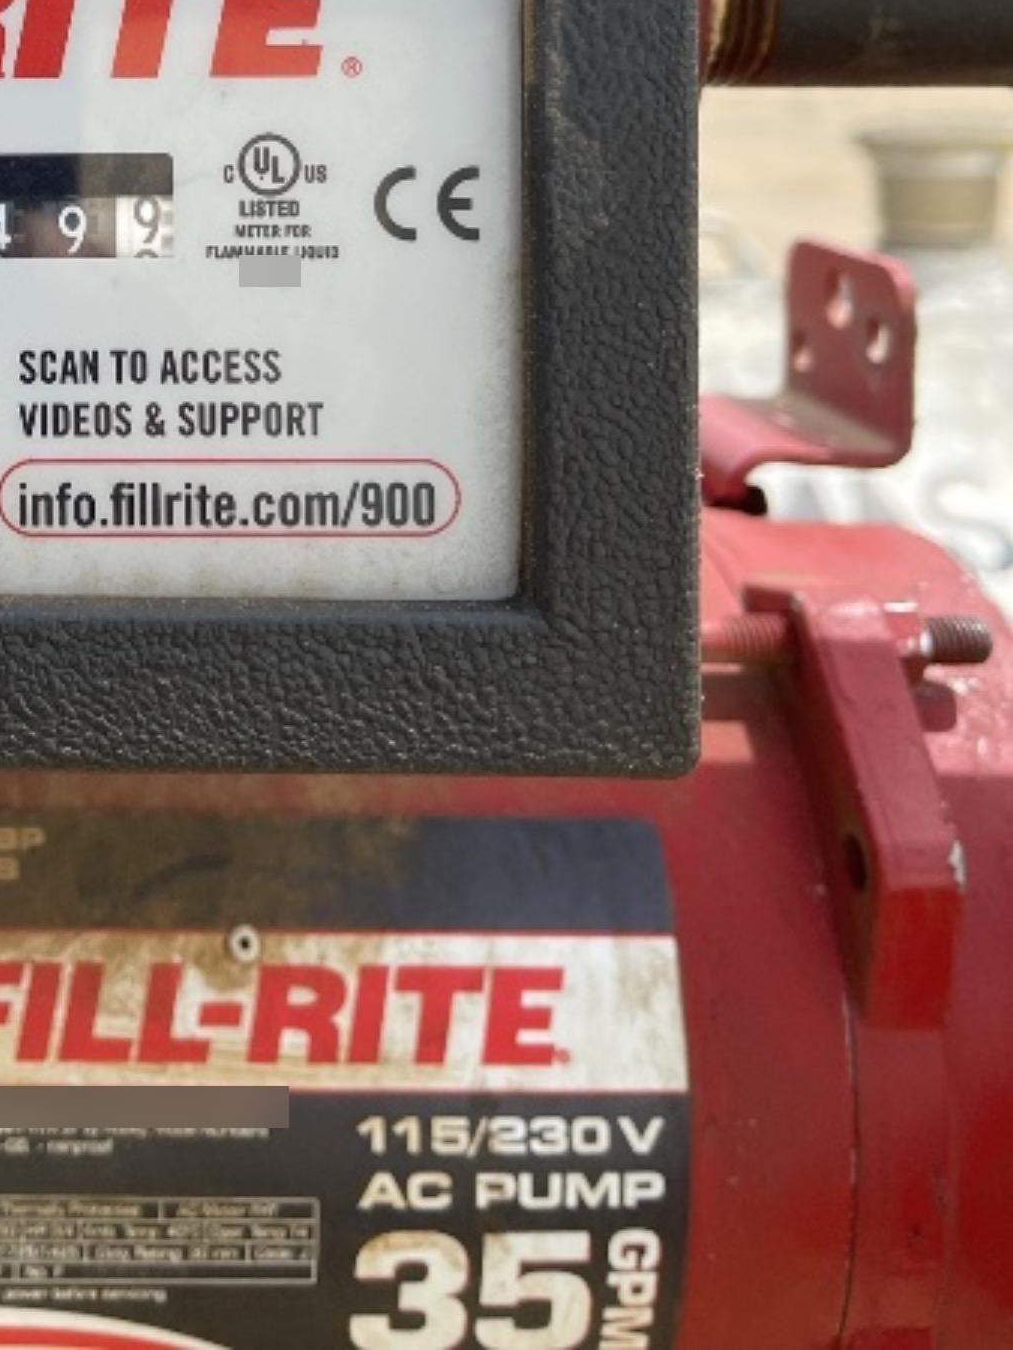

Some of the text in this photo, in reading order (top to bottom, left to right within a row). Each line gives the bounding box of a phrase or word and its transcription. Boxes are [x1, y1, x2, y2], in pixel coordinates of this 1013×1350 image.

[238, 200, 300, 217] LISTED
[19, 349, 282, 385] SCAN TO ACCESS
[19, 401, 324, 438] VIDEOS & SUPPORT
[18, 481, 436, 528] info.fillrite.com/900
[357, 1114, 666, 1159] 115/230 V
[357, 1170, 667, 1210] AC PUMP
[349, 1227, 662, 1350] 35 GPM
